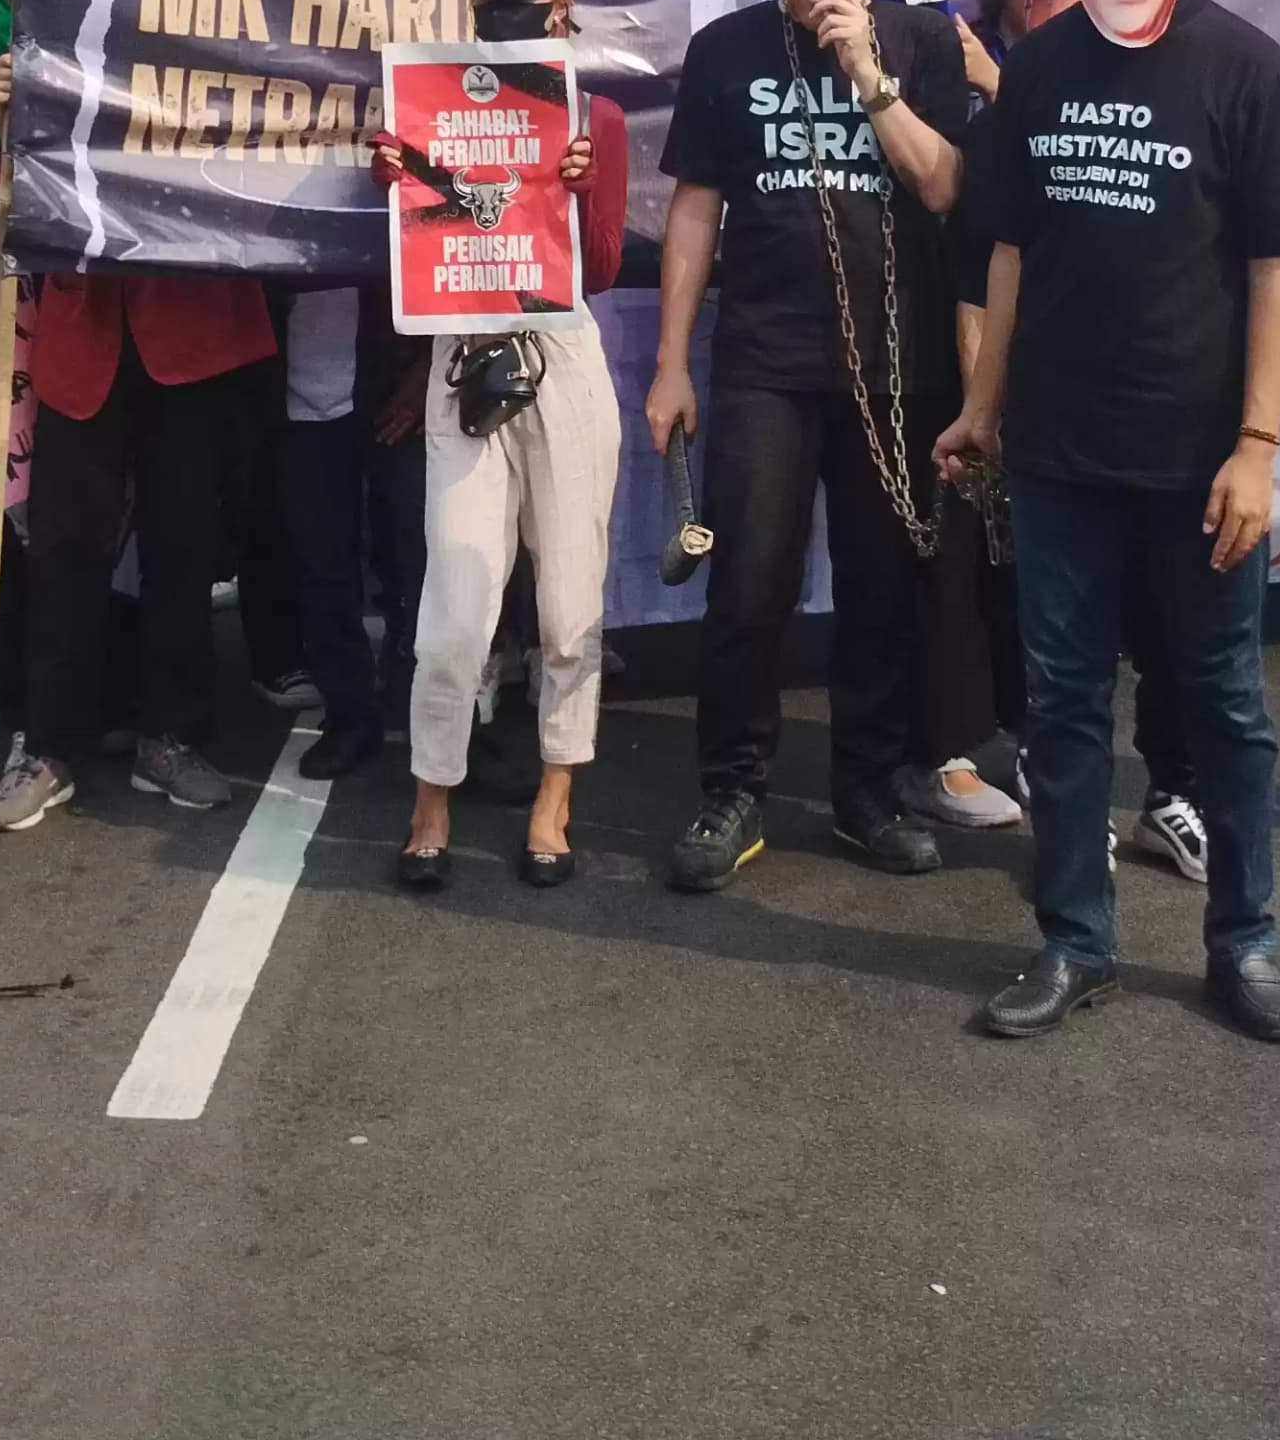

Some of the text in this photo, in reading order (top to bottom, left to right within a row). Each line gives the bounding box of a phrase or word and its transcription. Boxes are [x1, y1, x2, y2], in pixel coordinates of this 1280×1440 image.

[434, 109, 532, 137] SAHABAT
[1060, 102, 1152, 128] HASTO
[428, 138, 541, 167] PERADILAN
[756, 168, 845, 195] (HAKM
[1118, 169, 1150, 189] PDI
[443, 235, 534, 263] PERUSAK
[433, 263, 543, 293] PERADILAN
